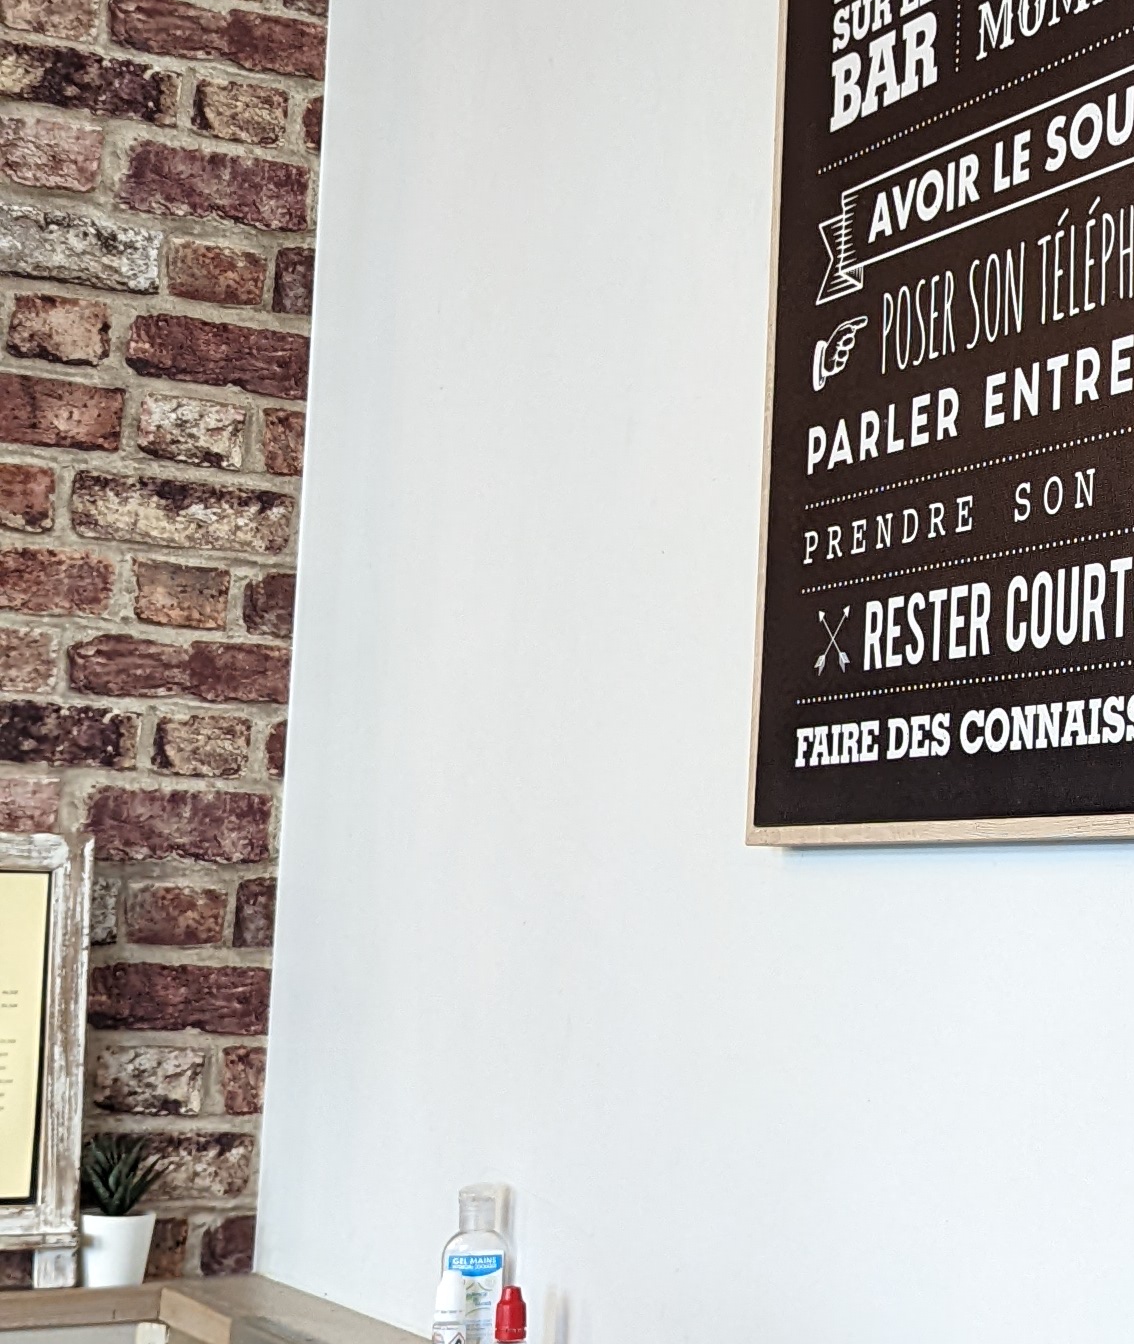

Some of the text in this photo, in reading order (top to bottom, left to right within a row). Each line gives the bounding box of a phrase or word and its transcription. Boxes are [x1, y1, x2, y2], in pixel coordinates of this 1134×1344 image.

[829, 11, 938, 133] BAR
[867, 153, 981, 244] AVOIR
[993, 129, 1031, 194] LE
[881, 270, 956, 375] POSER
[966, 241, 1026, 350] SON
[807, 387, 960, 476] PARLER
[984, 333, 1134, 429] ENTRE
[803, 494, 974, 565] PRENDRE
[1014, 467, 1096, 523] SON
[863, 581, 991, 671] RESTER
[794, 719, 880, 768] FAIRE
[886, 712, 951, 760] DES
[452, 1257, 467, 1265] GEL
